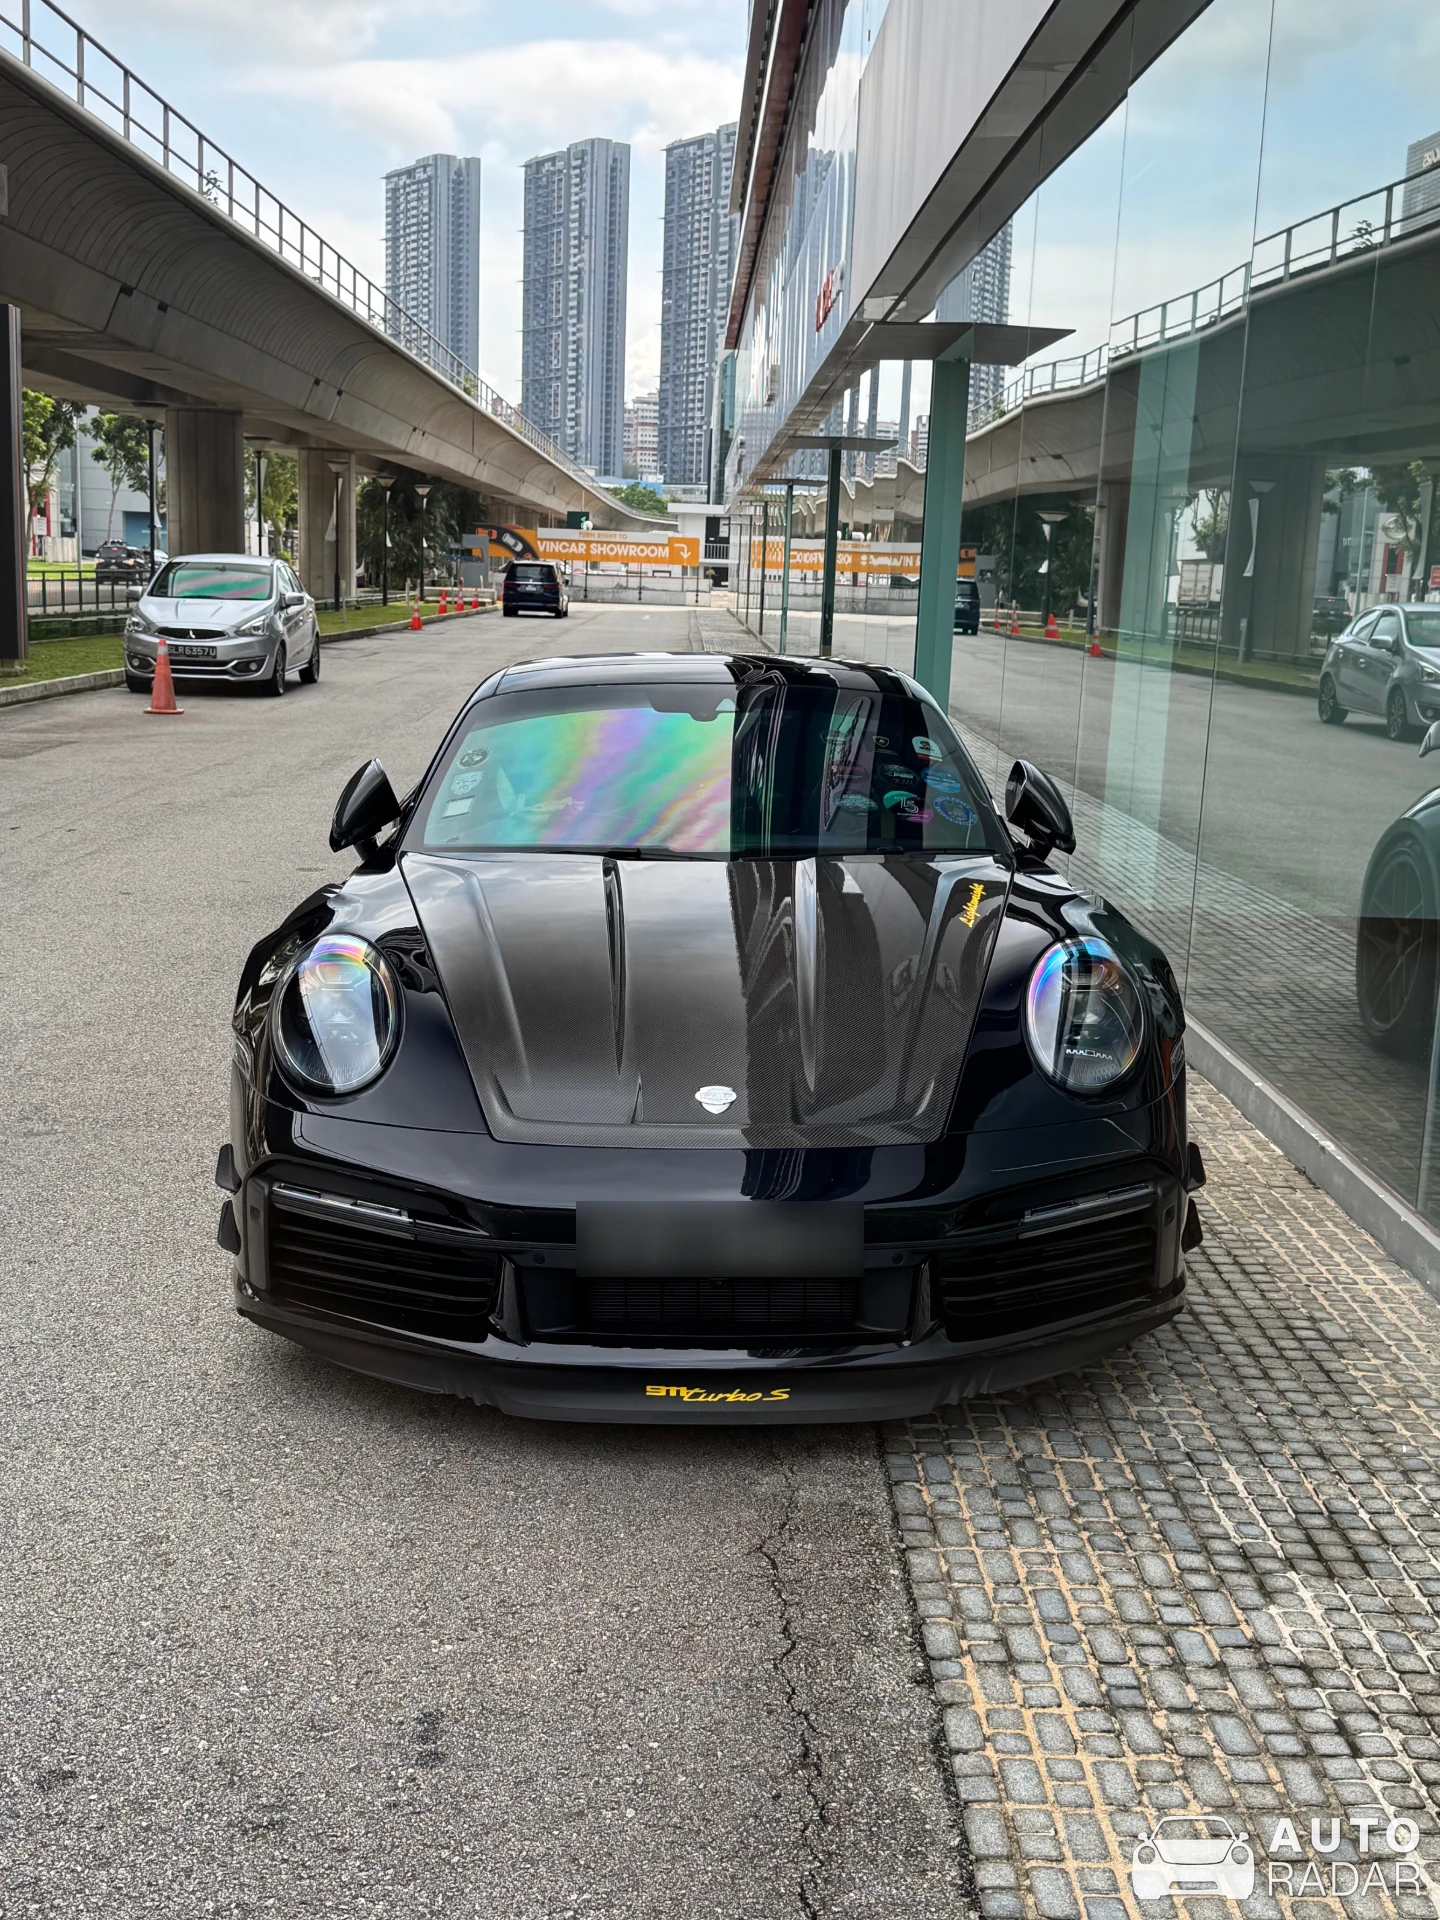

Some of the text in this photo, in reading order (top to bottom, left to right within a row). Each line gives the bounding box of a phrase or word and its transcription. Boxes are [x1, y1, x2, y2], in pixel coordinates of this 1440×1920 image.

[578, 531, 595, 539] TURN
[537, 540, 670, 558] VINCAR SHOWROOM
[761, 1388, 791, 1401] S
